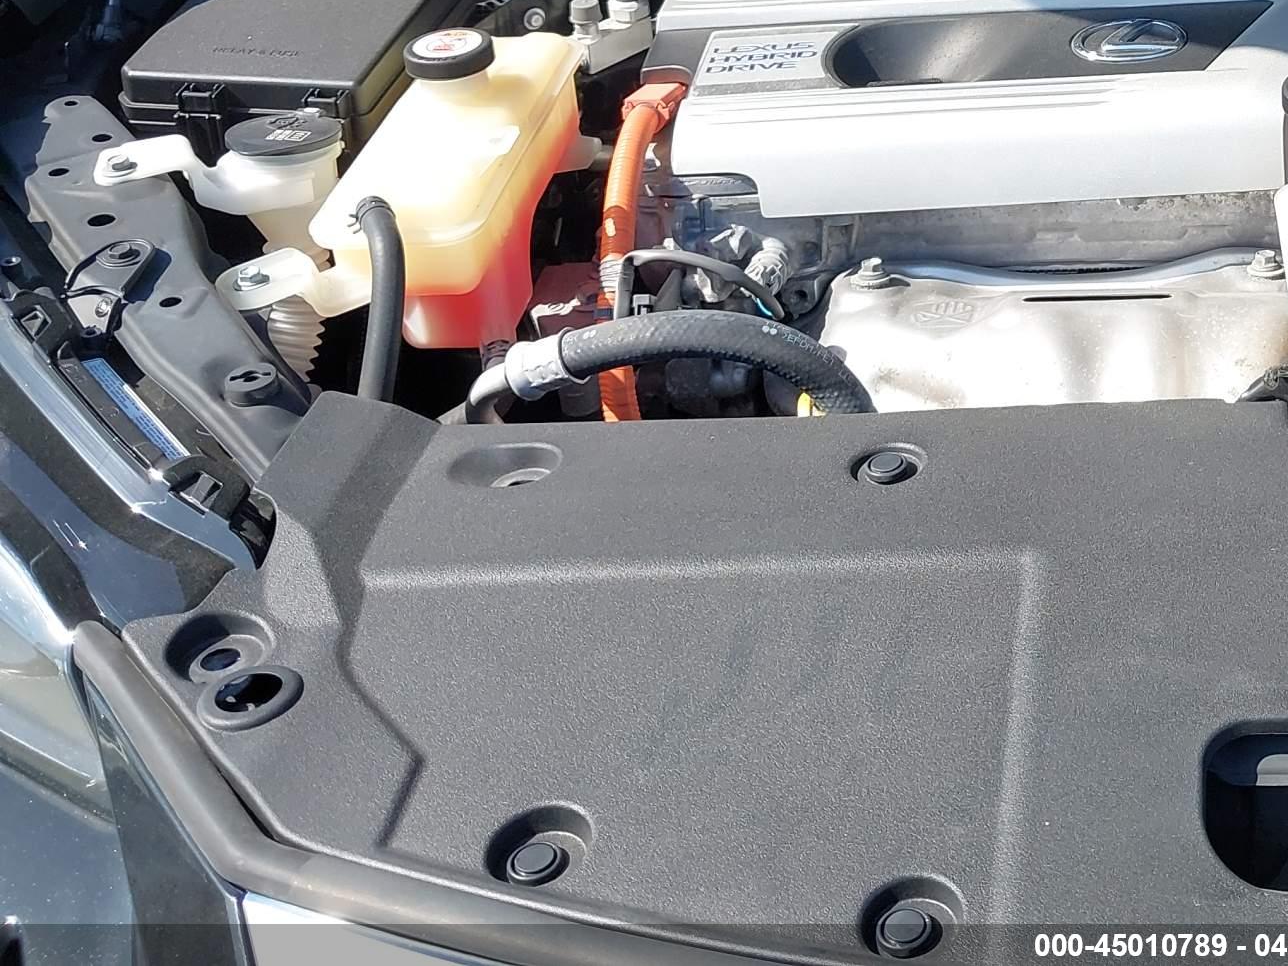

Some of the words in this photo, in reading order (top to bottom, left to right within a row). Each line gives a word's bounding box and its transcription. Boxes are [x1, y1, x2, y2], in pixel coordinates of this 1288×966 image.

[713, 41, 815, 54] LEXUS
[709, 50, 817, 64] HYBRID
[705, 60, 801, 74] DRIVE
